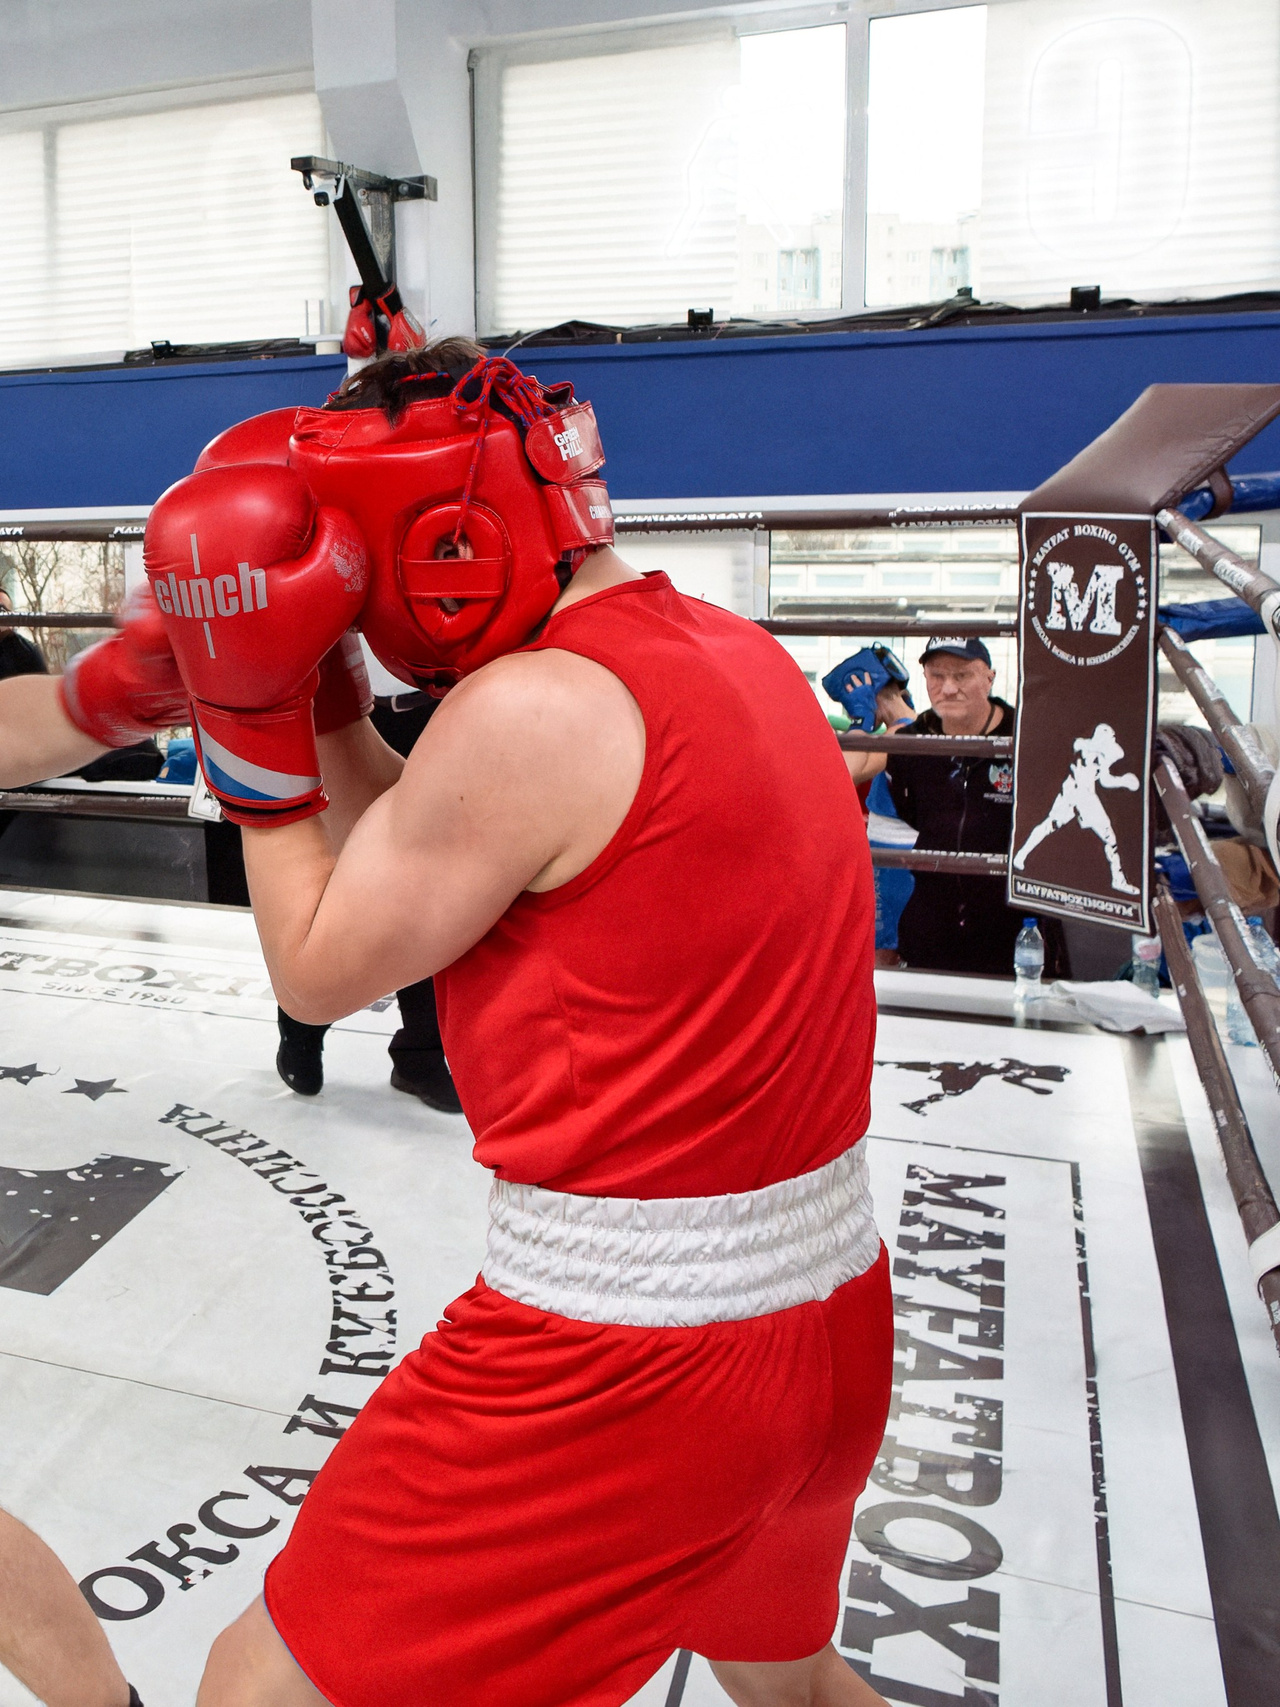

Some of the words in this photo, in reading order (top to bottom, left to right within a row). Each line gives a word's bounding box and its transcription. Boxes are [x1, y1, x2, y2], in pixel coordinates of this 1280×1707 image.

[559, 440, 584, 462] HILL
[1032, 527, 1070, 567] MAYFAT
[1074, 524, 1118, 546] BOXING
[1118, 542, 1141, 573] GYM
[154, 562, 268, 618] clinch
[1045, 561, 1125, 636] M
[78, 1463, 320, 1621] ОКСА
